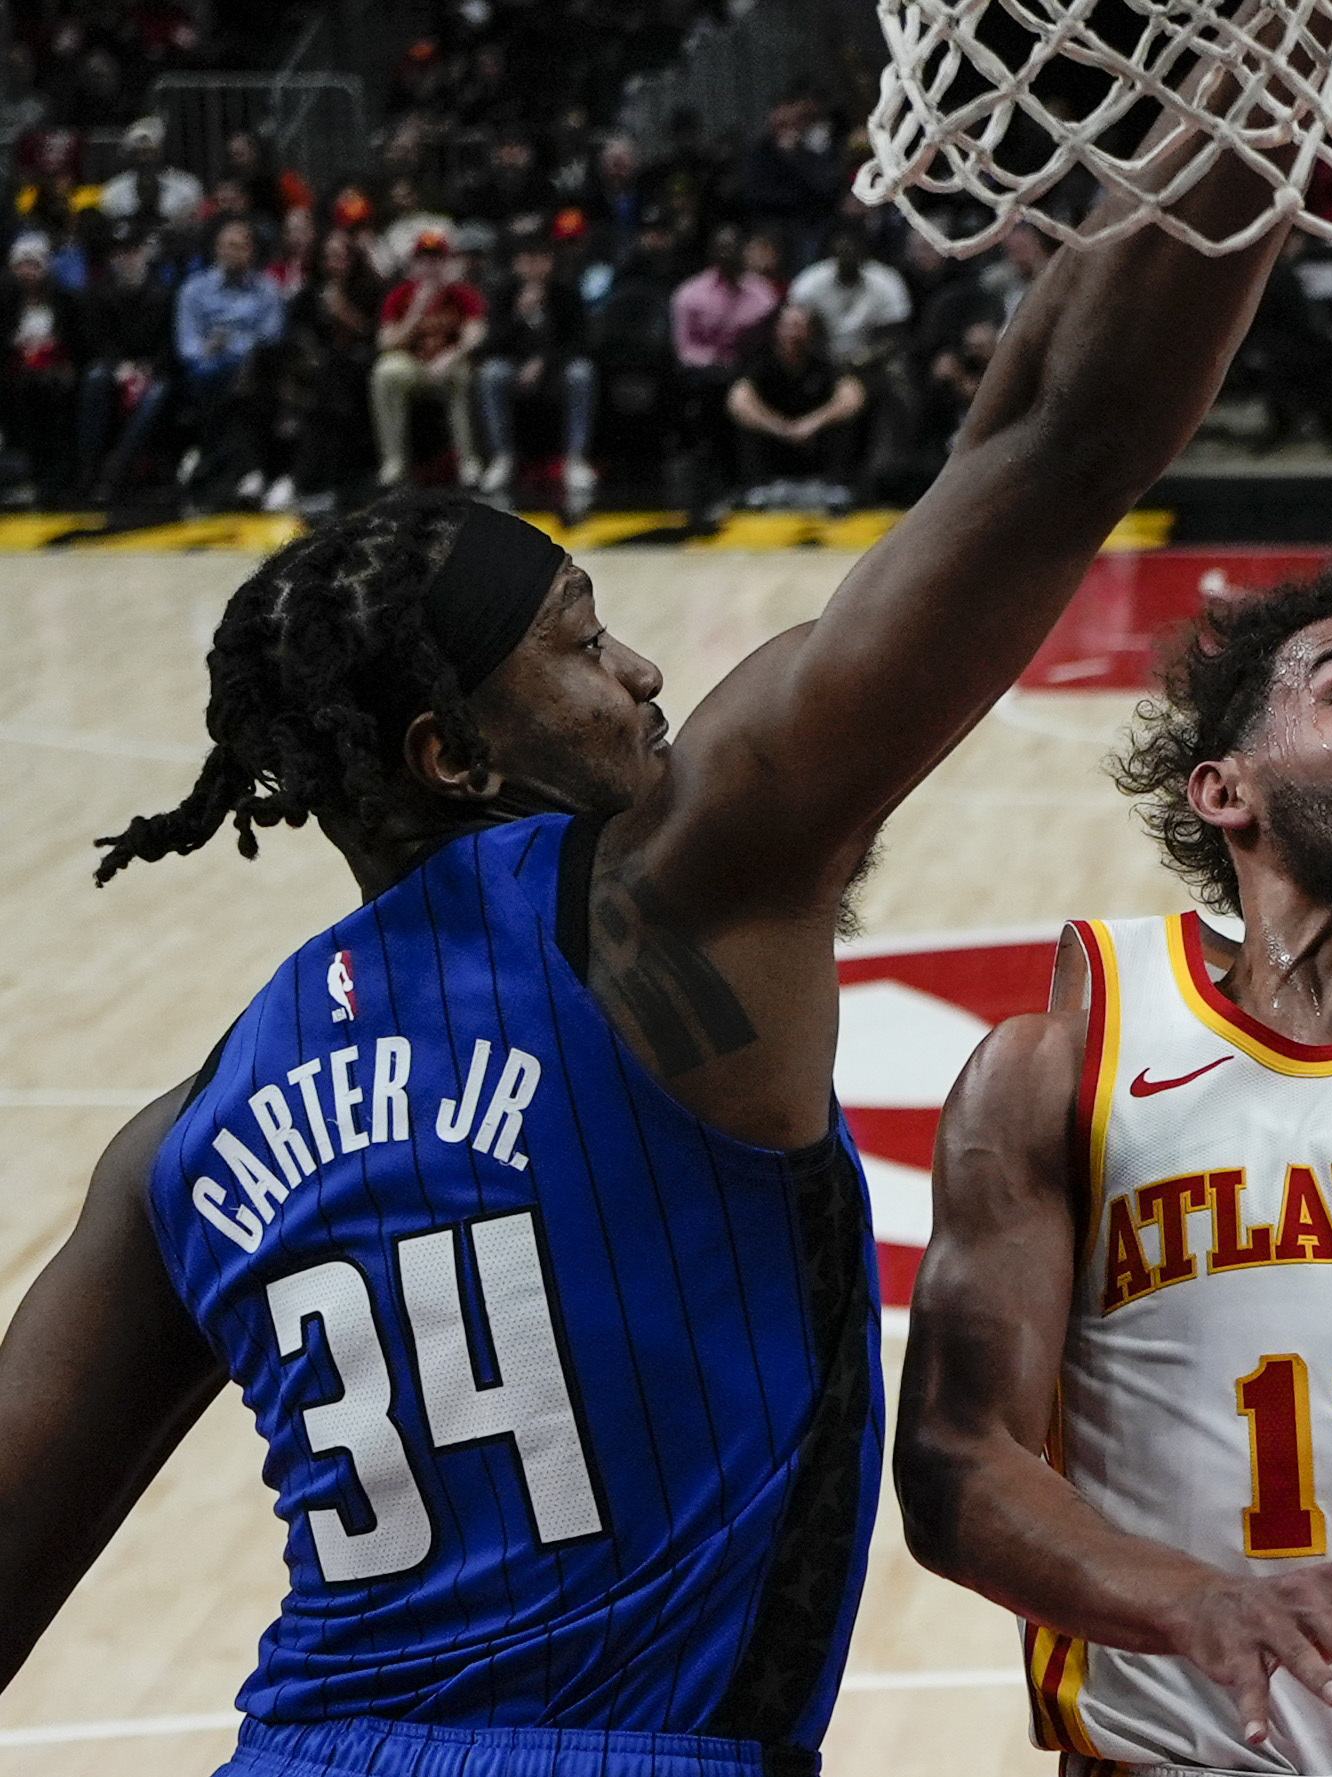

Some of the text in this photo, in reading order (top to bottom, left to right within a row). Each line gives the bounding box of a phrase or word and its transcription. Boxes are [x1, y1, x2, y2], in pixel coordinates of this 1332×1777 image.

[192, 1035, 542, 1254] CARTER JR.
[264, 1208, 605, 1584] 34
